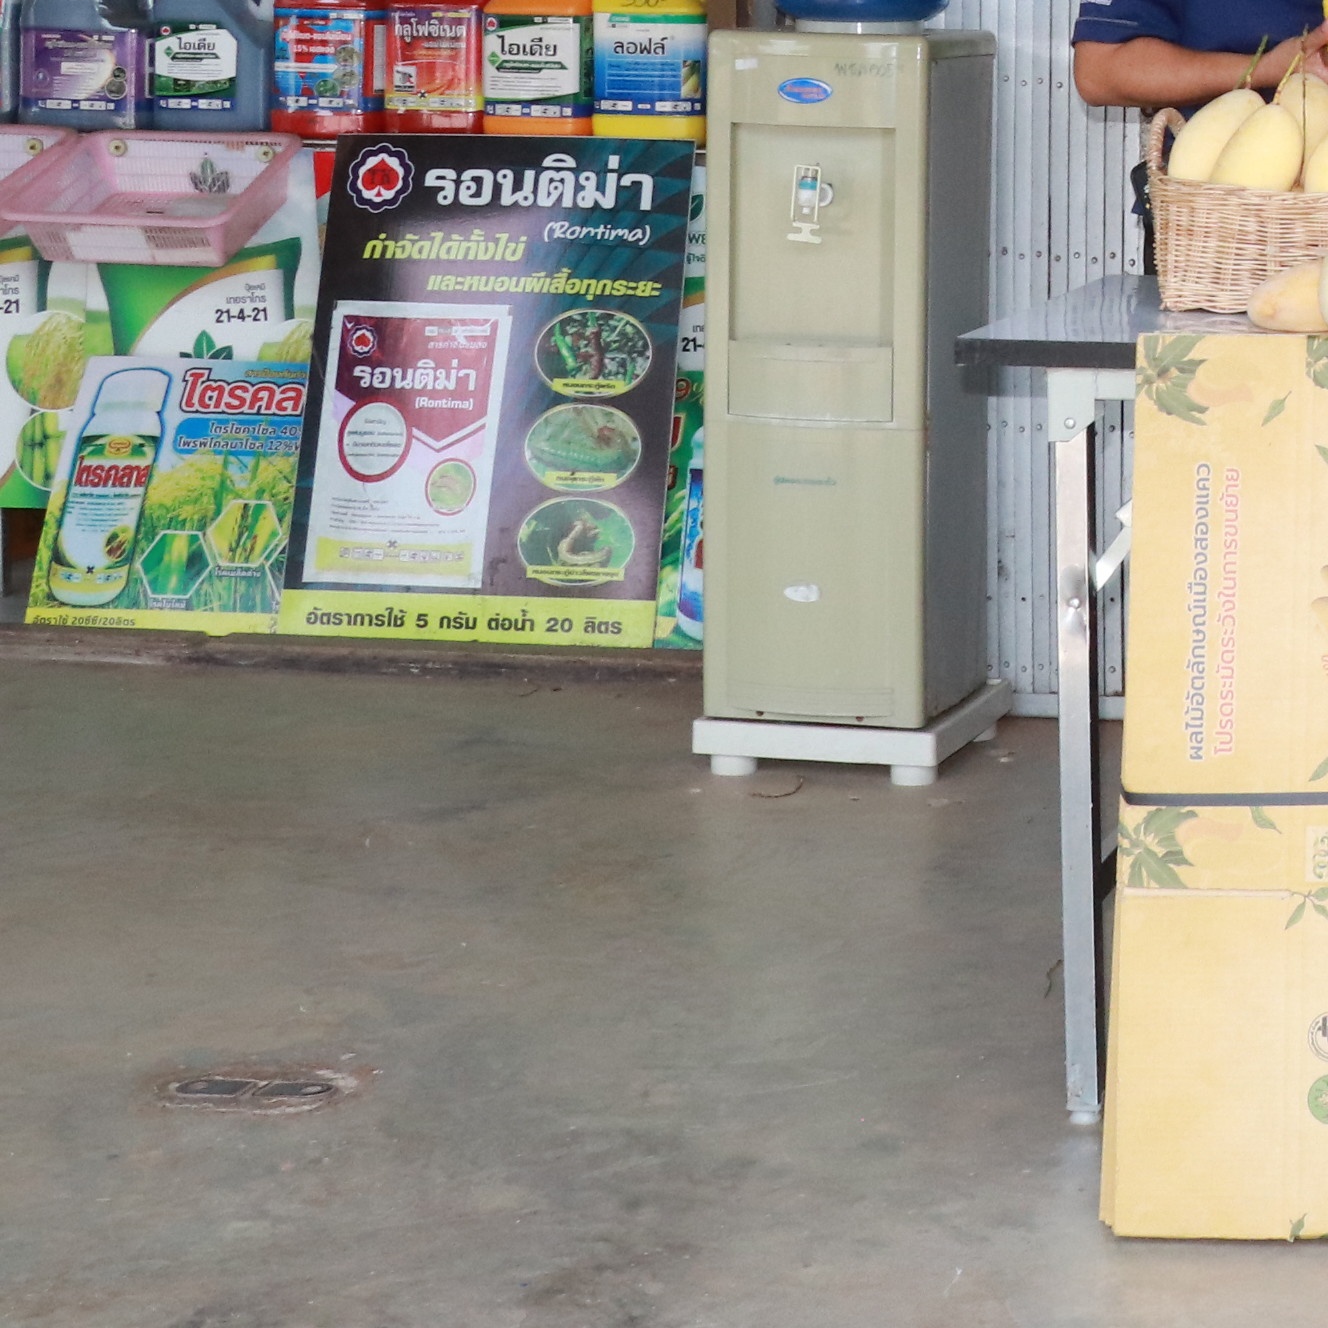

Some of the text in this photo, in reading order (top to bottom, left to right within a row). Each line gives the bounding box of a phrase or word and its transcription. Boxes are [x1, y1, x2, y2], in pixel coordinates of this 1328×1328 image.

[176, 37, 216, 51] ไอเดีย
[496, 34, 557, 57] ไอเดีย
[424, 152, 654, 212] รอนติม่า
[363, 228, 528, 262] กำจัดได้ทั้งไข่
[543, 220, 651, 246] (Rontima)
[426, 267, 663, 301] และหนอนผีเสื้อทุกระยะ
[215, 307, 268, 324] 21-4-21
[352, 358, 477, 391] รอนติม่า
[415, 397, 474, 411] (Rontima)
[305, 606, 623, 636] อัตราการใช้ 5 กรัม ต่อน้ำ 20 ลิตร
[1184, 462, 1212, 761] ผลไม้อัตลักษณ์เมืองสองแคว
[1214, 467, 1241, 756] โปรดระมัดระวังในการขนย้าย
